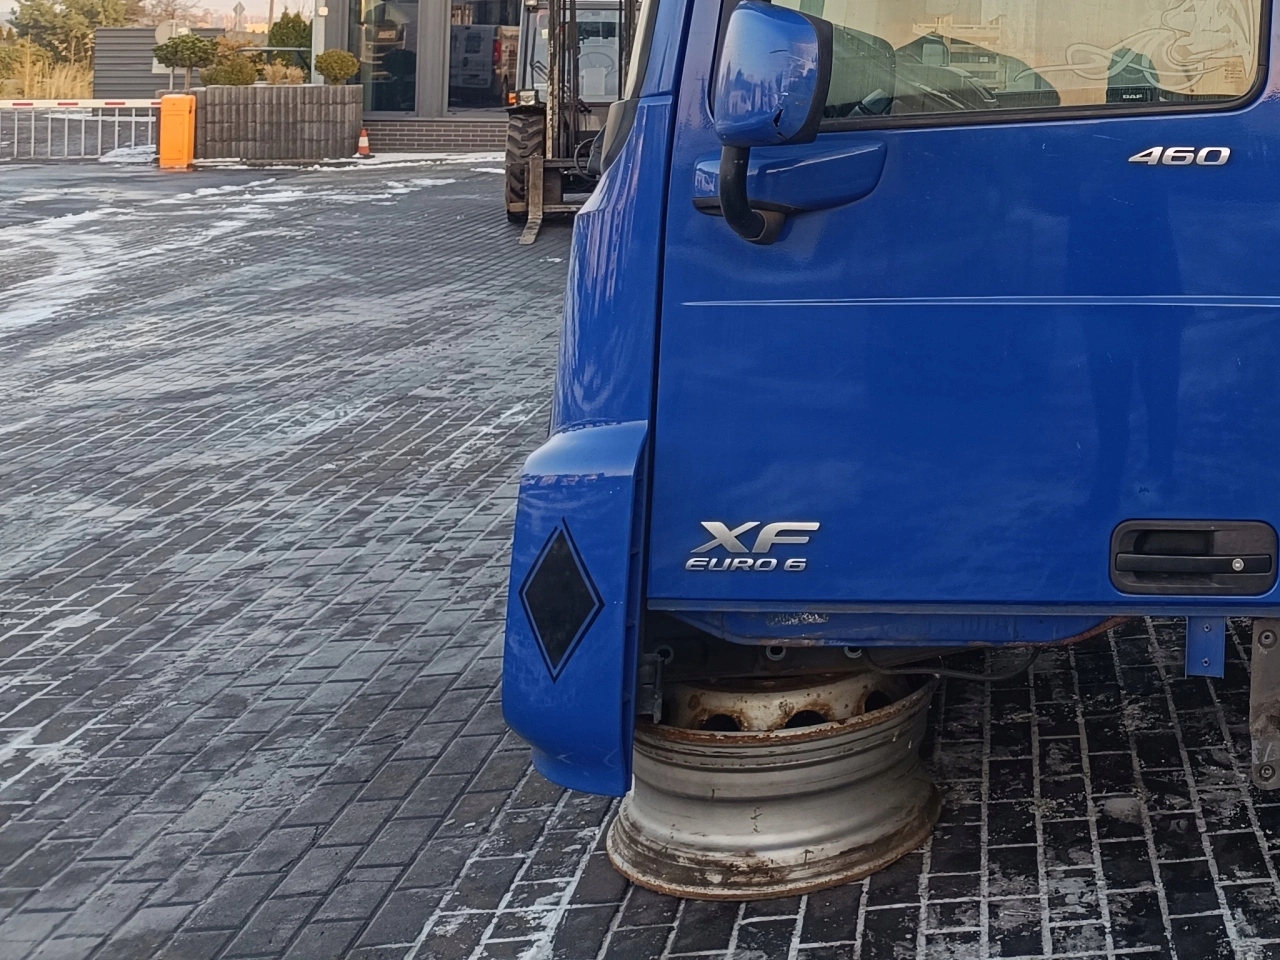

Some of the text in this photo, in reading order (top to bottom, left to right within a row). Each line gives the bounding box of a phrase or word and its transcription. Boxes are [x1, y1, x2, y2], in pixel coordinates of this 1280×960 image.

[1128, 146, 1231, 166] 460
[690, 521, 821, 553] XF
[685, 557, 807, 571] EURO 6
